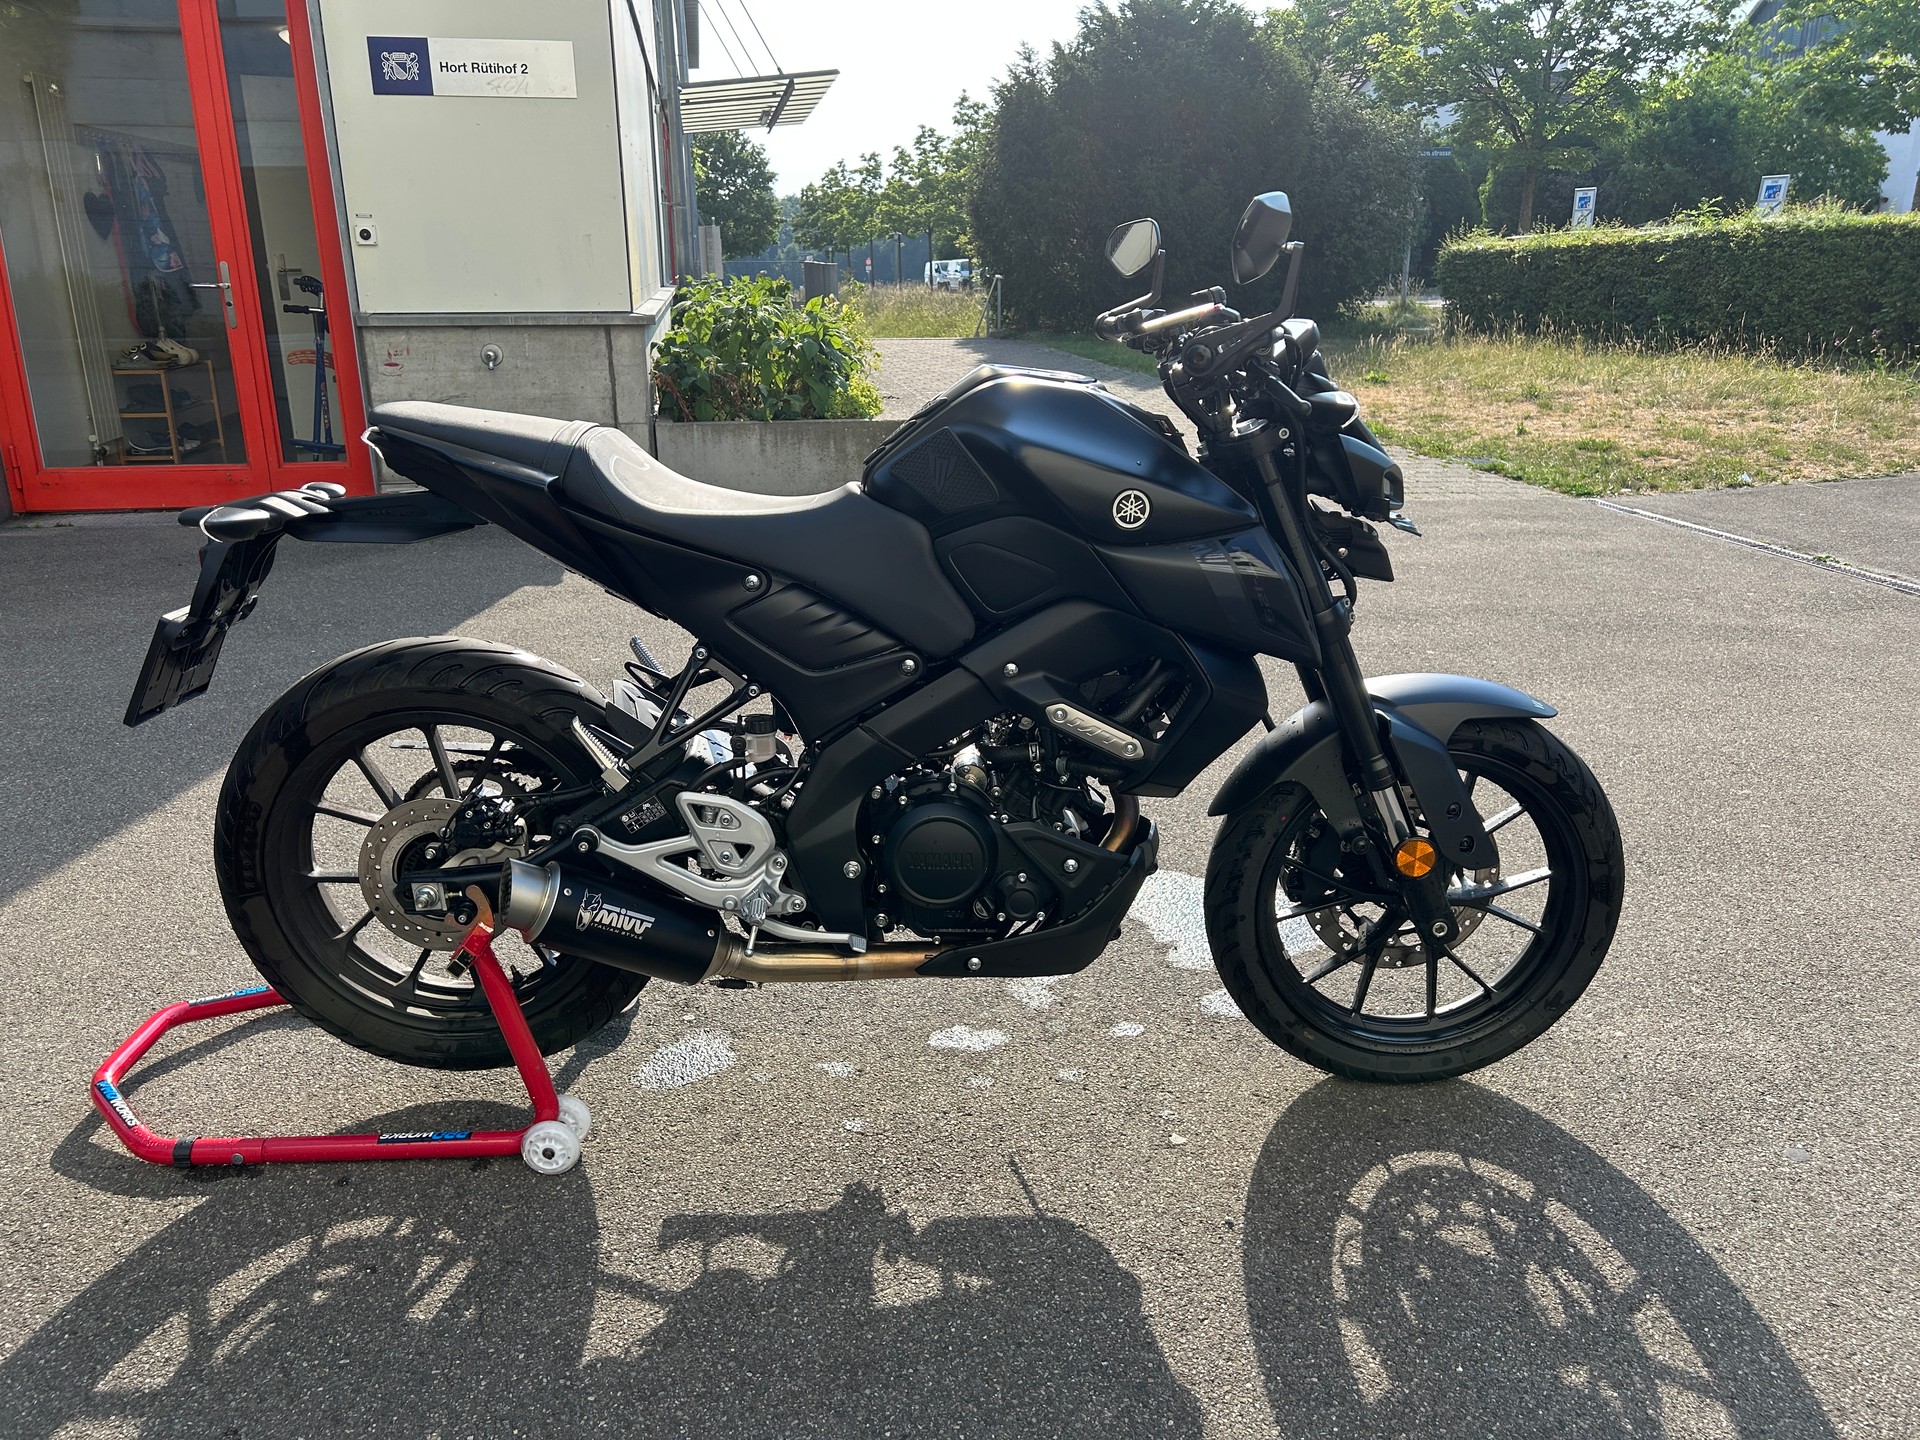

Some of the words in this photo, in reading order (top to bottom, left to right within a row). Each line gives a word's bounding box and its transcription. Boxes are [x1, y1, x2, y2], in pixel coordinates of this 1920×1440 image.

[439, 61, 468, 73] Hort
[471, 62, 517, 74] Rütihof
[520, 63, 529, 75] 2
[909, 852, 974, 870] YAMAHA
[590, 922, 620, 934] ITALIAN
[620, 931, 644, 940] STYLE
